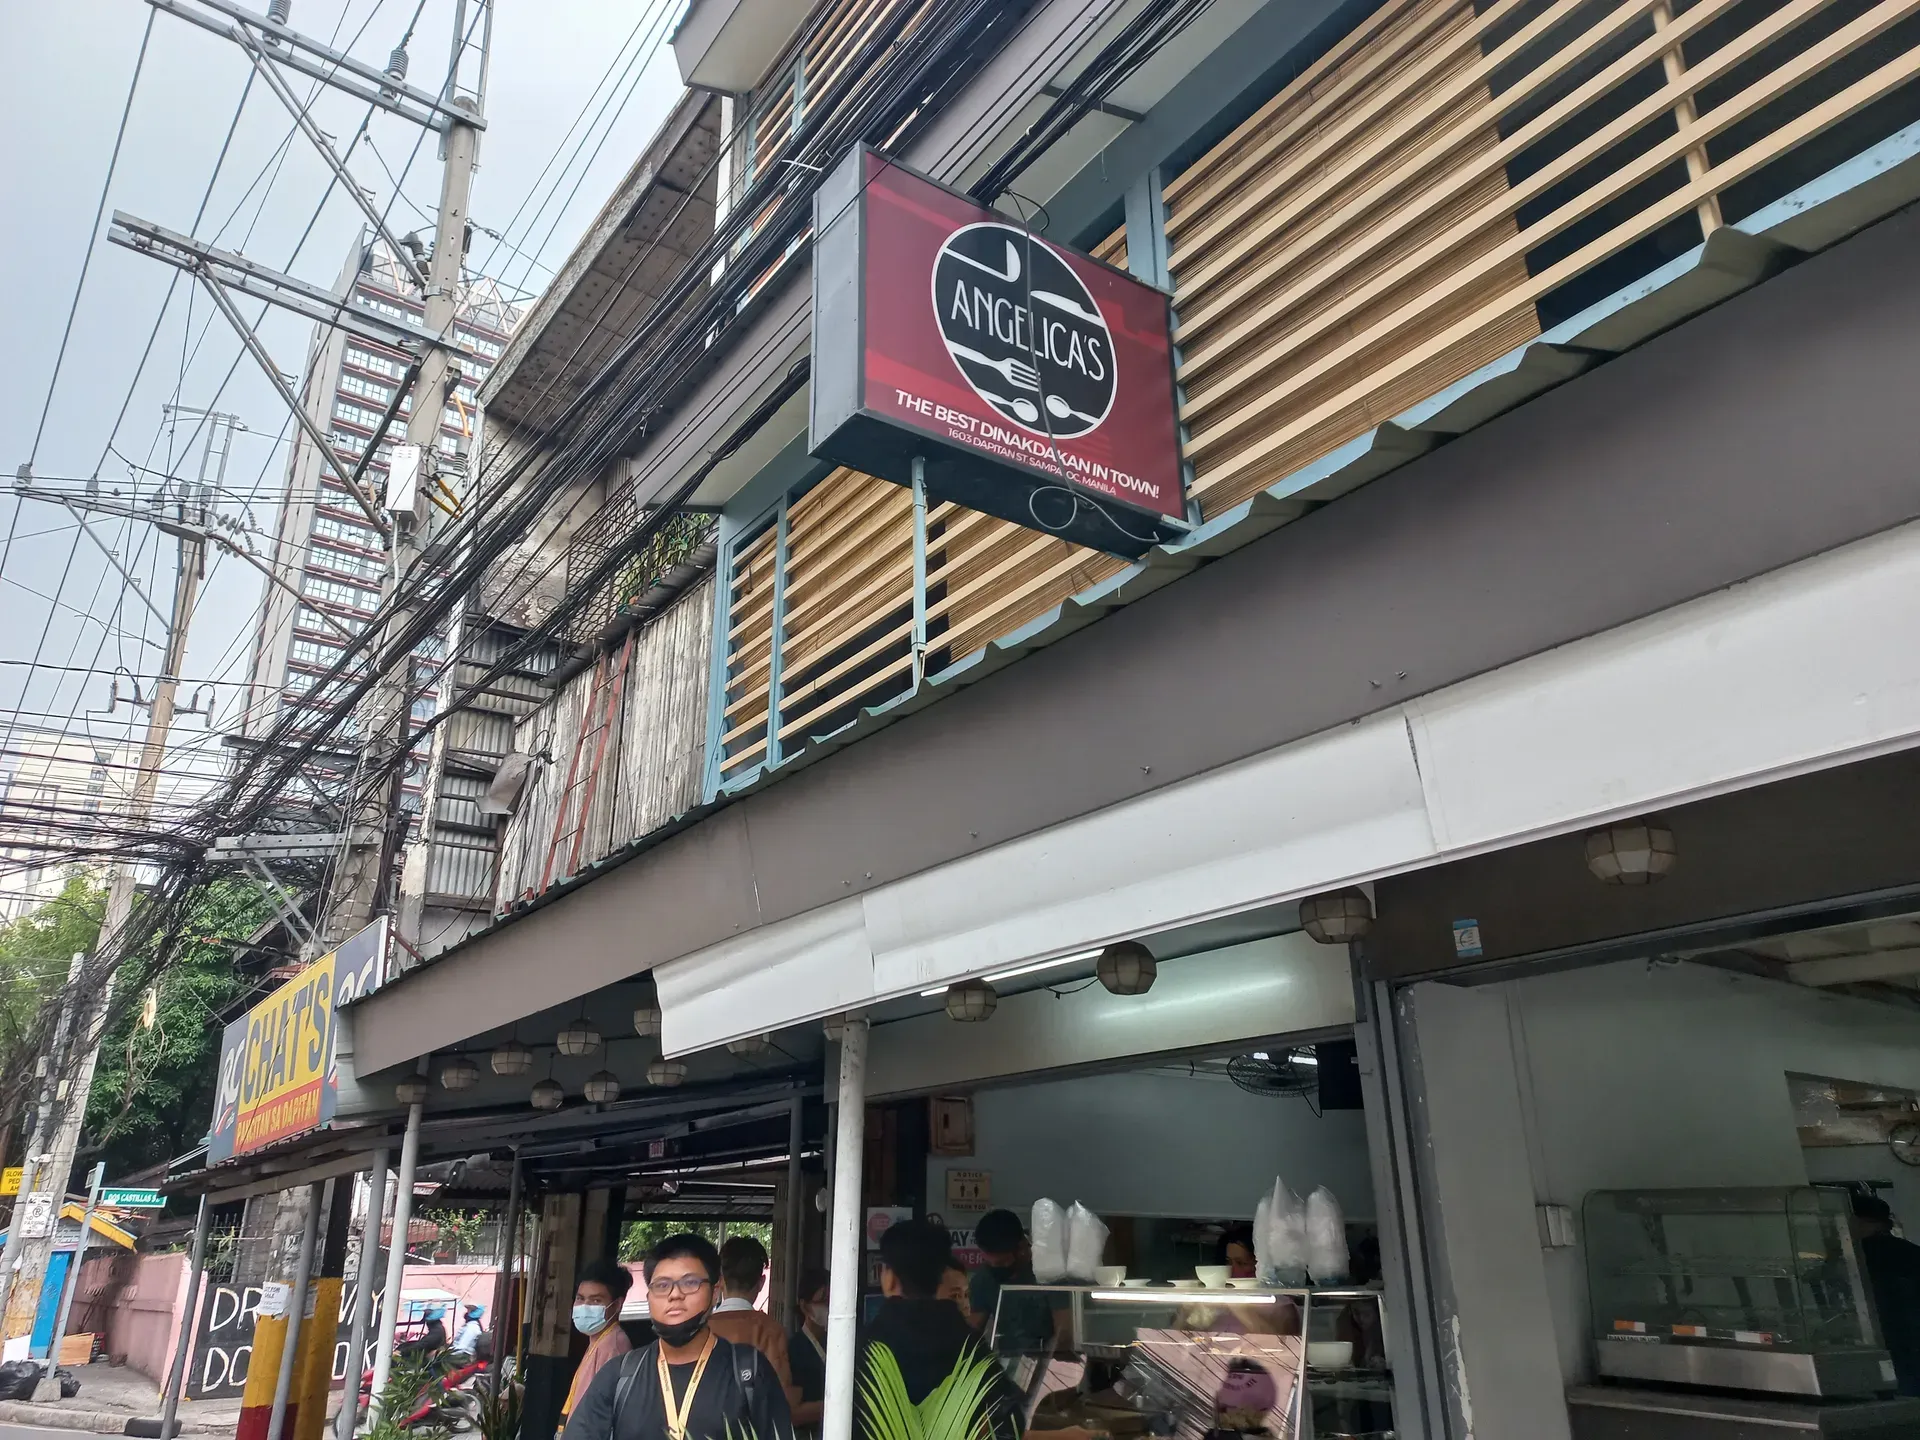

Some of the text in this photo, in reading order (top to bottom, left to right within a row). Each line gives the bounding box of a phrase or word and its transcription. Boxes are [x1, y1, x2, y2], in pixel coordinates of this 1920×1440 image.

[951, 279, 1104, 381] ANGELICA'S
[895, 389, 1160, 499] THE BEST DINAKDAKAN IN TOWN!
[948, 427, 972, 443] 1603
[973, 437, 1016, 459] DAPITAN
[1028, 456, 1082, 484] SAMPAOC,
[1081, 476, 1117, 496] MANILA
[244, 972, 329, 1105] CHAT'S
[281, 1087, 320, 1129] DAPITAN
